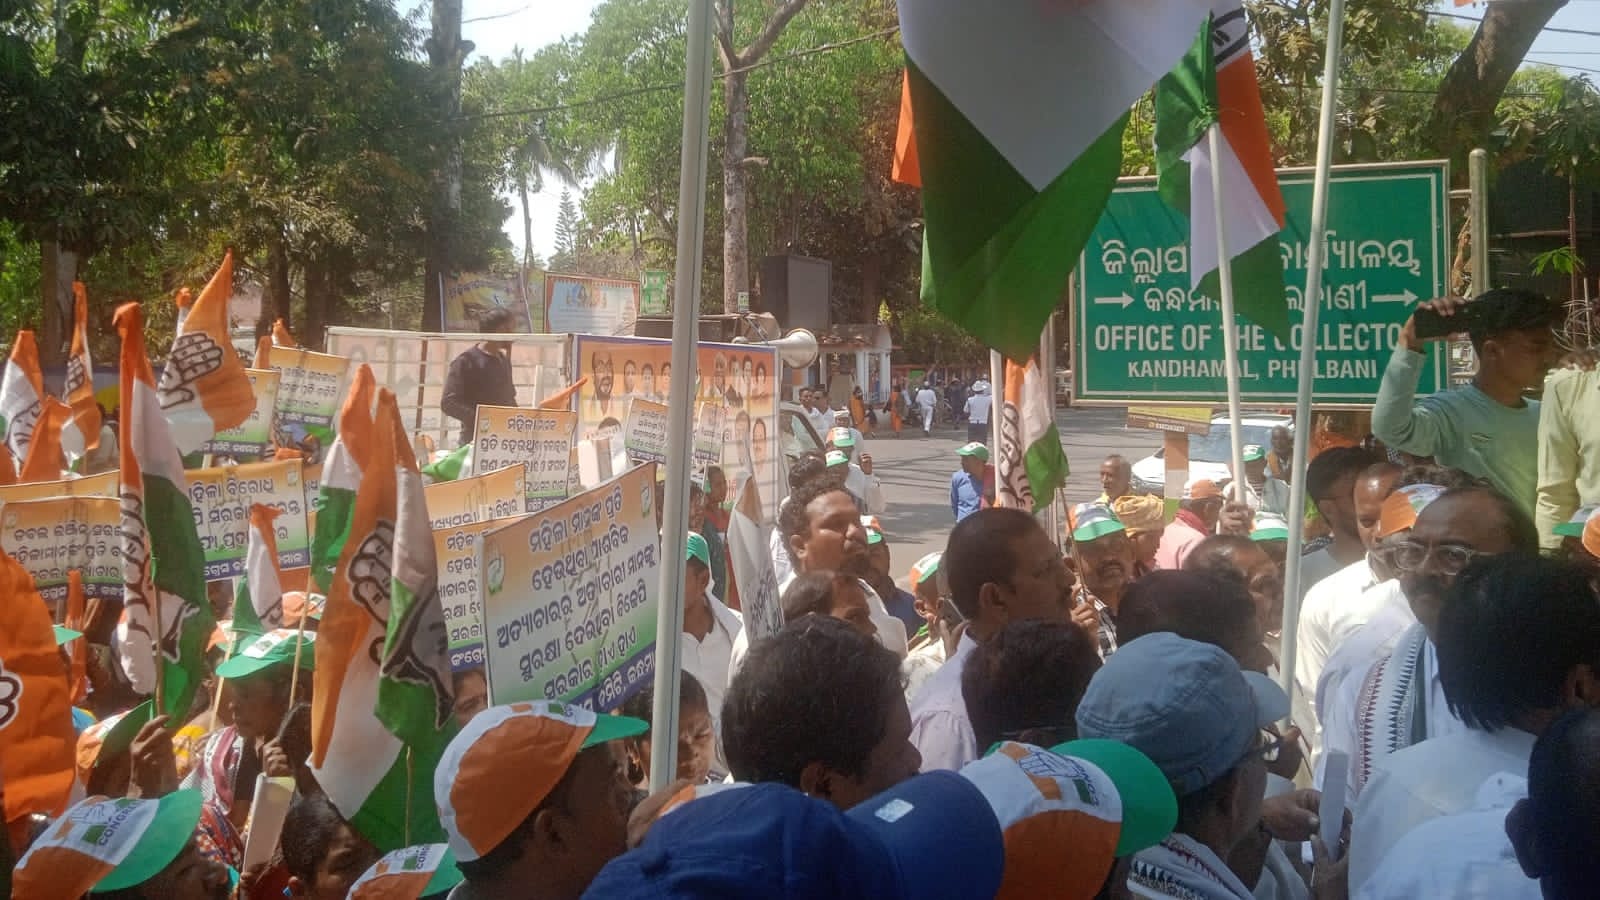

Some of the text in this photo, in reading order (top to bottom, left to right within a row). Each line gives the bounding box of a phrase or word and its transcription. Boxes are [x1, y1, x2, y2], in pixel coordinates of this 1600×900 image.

[1101, 239, 1188, 284] ଜିଲ୍ଲାପ
[1143, 287, 1221, 312] କନ୍ଧମା
[1094, 323, 1402, 352] OFFICE OF HE OLECTO
[1267, 358, 1377, 379] PHLBANI
[188, 481, 222, 504] ହିଳା
[208, 506, 249, 523] ସରକା
[529, 518, 568, 553] ମହିଳା
[605, 485, 623, 518] ପ୍ରତି
[450, 623, 483, 642] ସରକା
